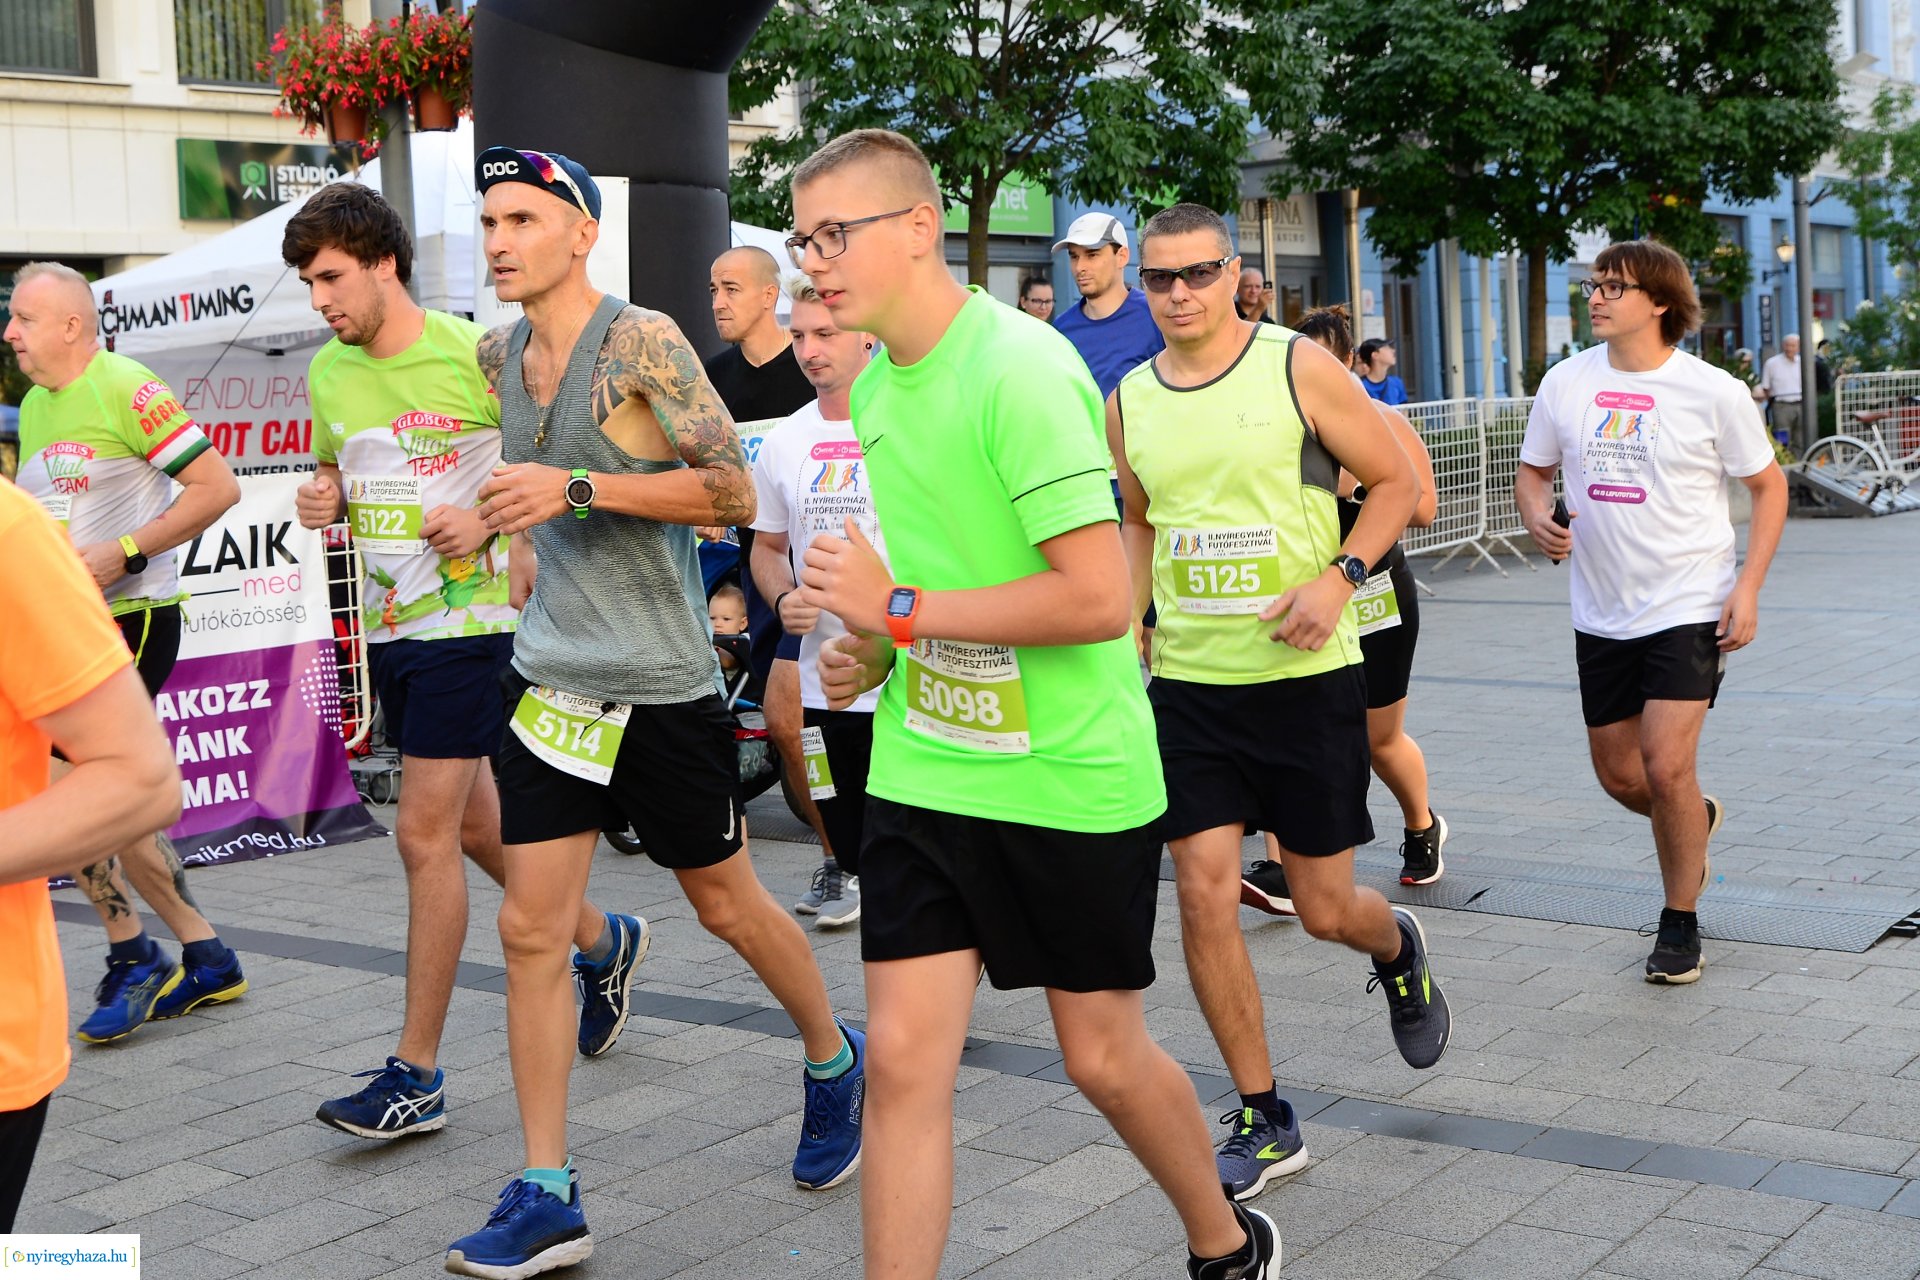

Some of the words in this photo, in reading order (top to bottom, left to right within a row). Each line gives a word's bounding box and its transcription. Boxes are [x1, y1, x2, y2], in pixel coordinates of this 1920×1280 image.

[277, 163, 339, 184] STÚDIÓ
[180, 284, 254, 322] TIMING
[135, 382, 166, 406] GLO
[183, 376, 310, 410] ENDURA
[397, 413, 455, 429] GLOBUS
[46, 443, 88, 456] GLOBUS
[396, 429, 456, 459] Vital
[1587, 450, 1647, 462] FUTÓFESZTIVÁL
[1596, 442, 1648, 453] NYÍREGYHÁZI
[44, 454, 85, 480] Vital
[407, 450, 459, 477] TEAM
[51, 476, 89, 494] TEAM
[369, 488, 418, 496] FUTÓFESZTIVÁL
[804, 505, 867, 515] FUTÓFESZTIVÁL
[813, 495, 867, 505] NYÍREGYHÁZI
[357, 508, 408, 536] 5122
[1208, 538, 1273, 550] FUTÓFESZTIVÁL
[243, 567, 301, 597] med
[1188, 563, 1261, 594] 5125
[937, 651, 1012, 669] FUTÓFESZTIVÁL
[562, 694, 627, 715] FUTÓFESVÁL
[919, 671, 1003, 727] 5098
[166, 726, 252, 765] ÁNK
[533, 710, 603, 757] 5114
[805, 760, 820, 784] 4
[181, 831, 327, 864] aikmed.hu
